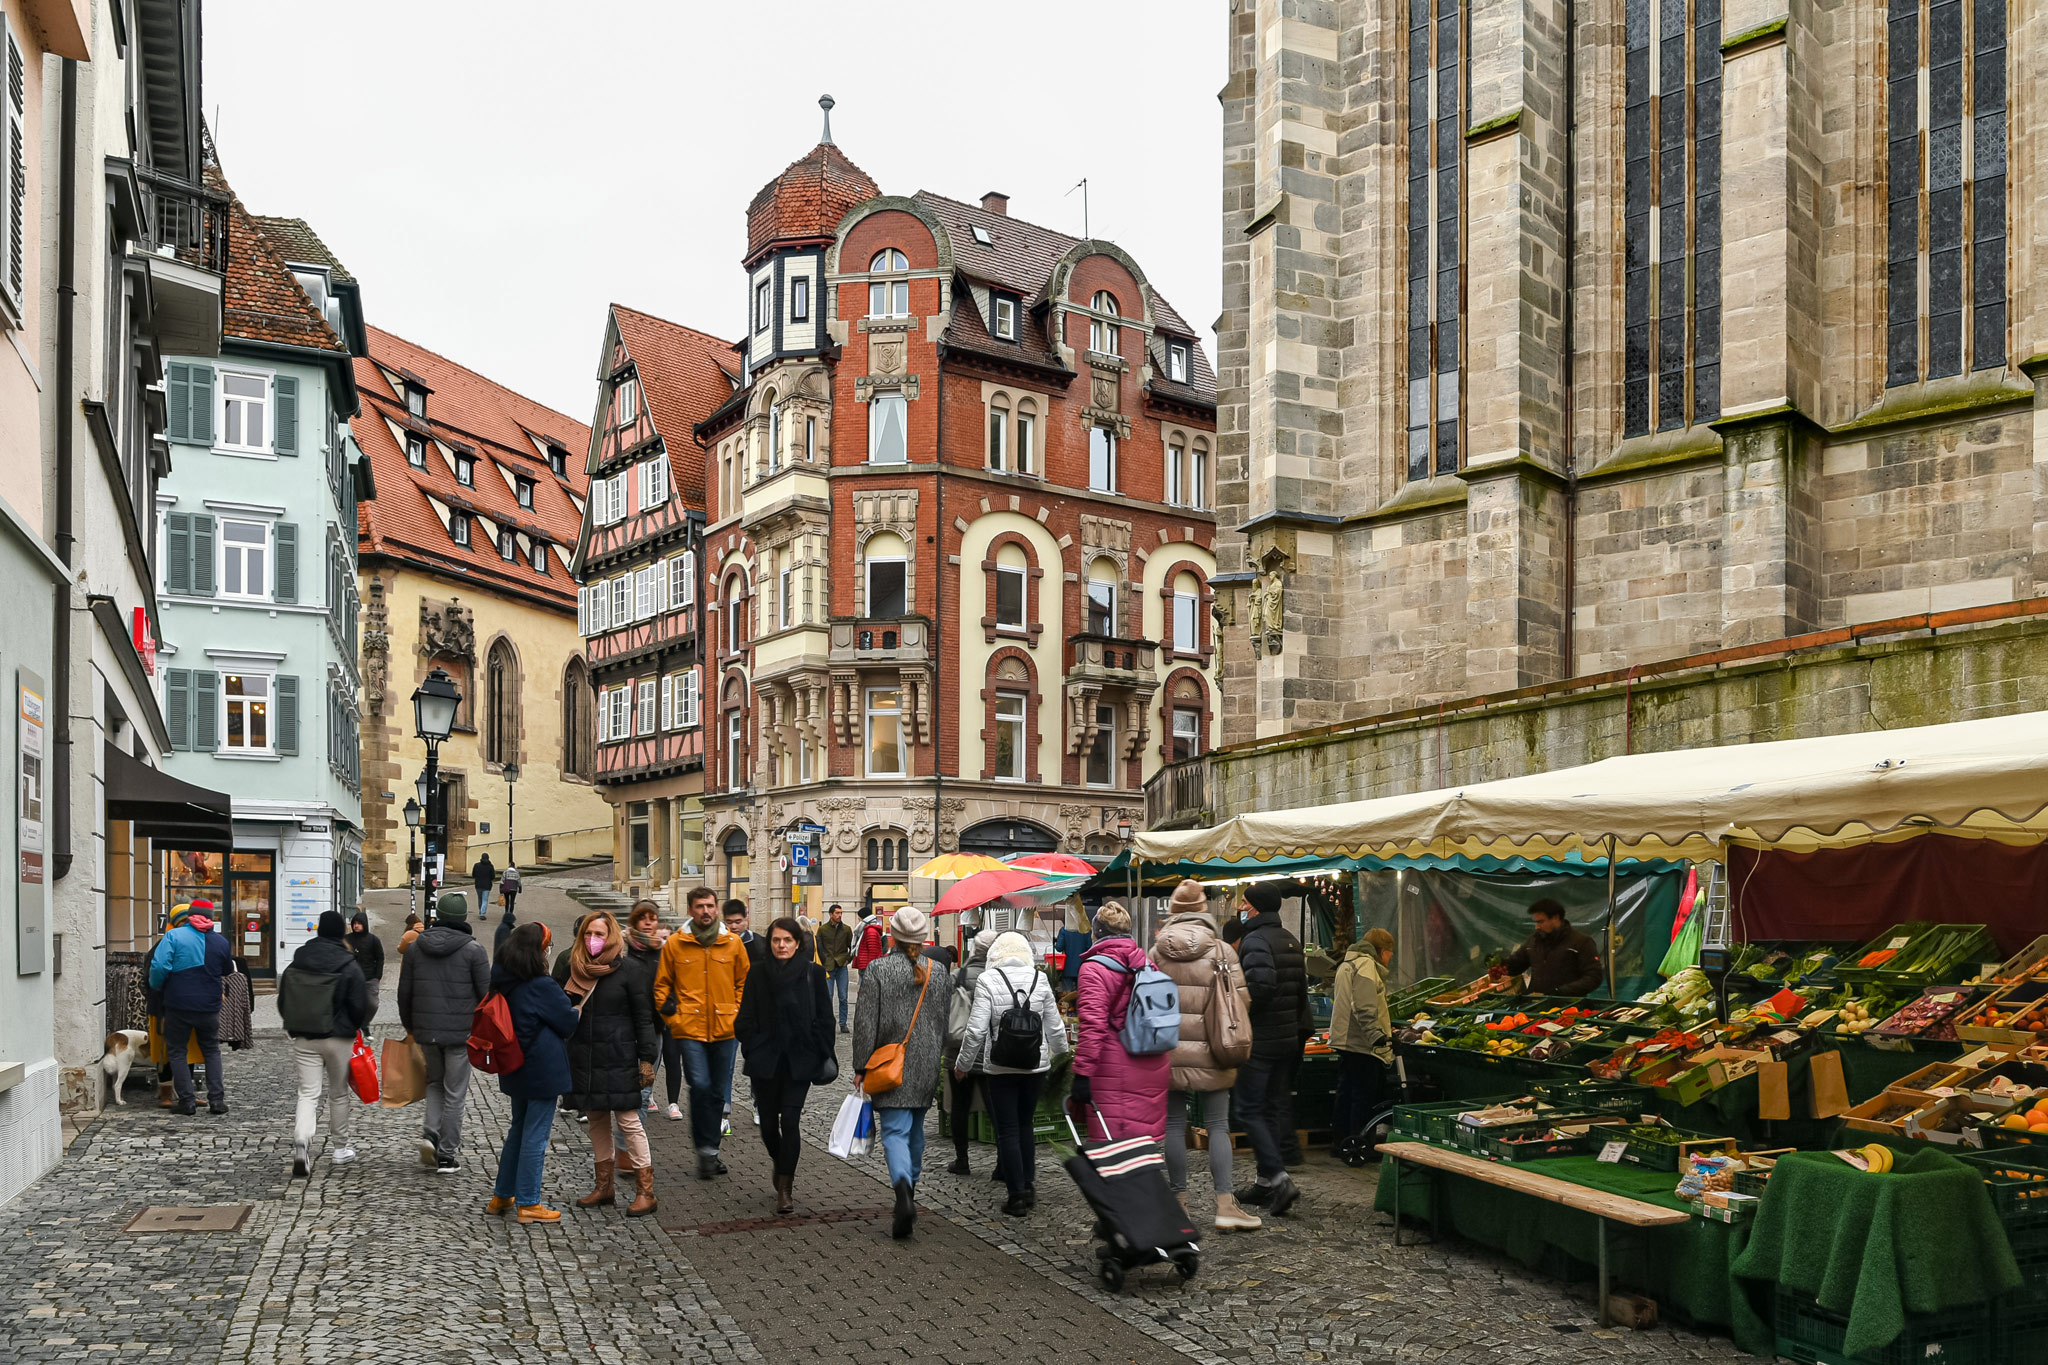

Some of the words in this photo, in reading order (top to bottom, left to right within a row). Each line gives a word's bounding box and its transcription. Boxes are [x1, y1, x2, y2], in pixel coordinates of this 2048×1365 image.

[792, 833, 810, 841] Polizei
[795, 847, 805, 863] P
[1156, 899, 1171, 911] LU
